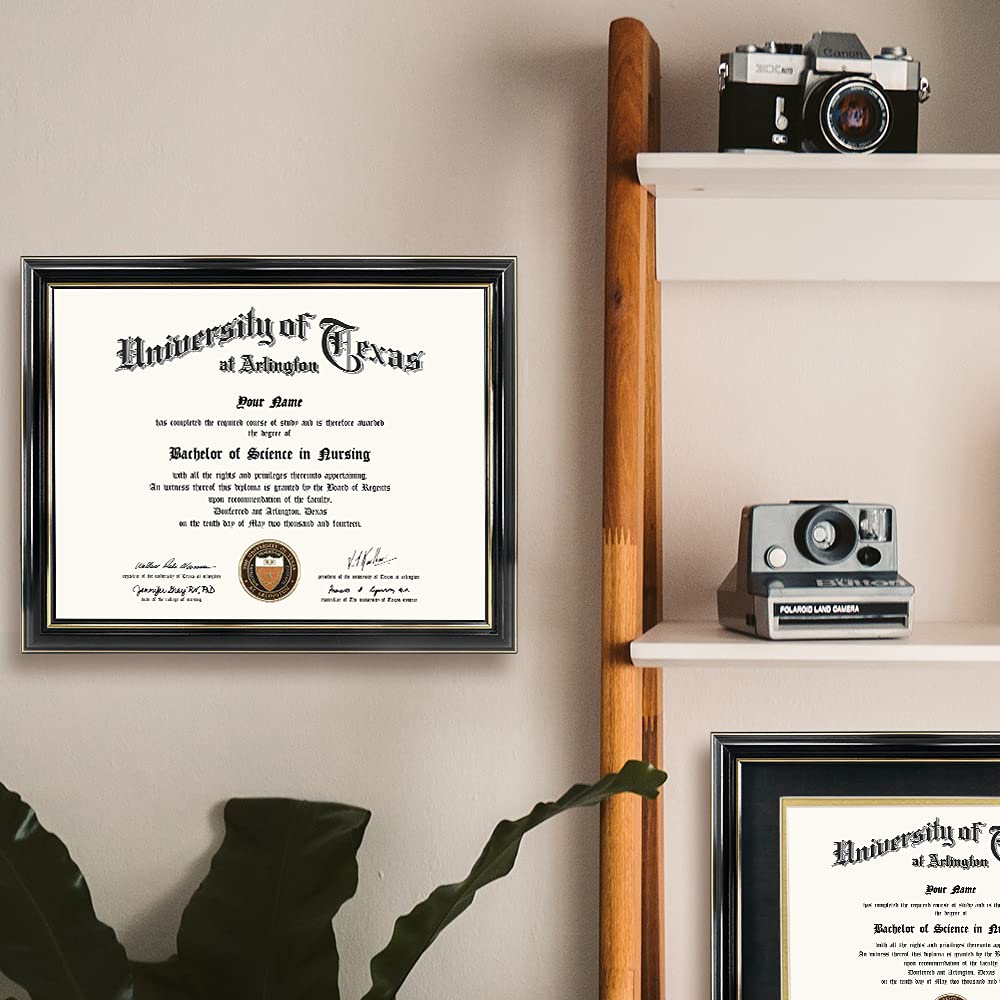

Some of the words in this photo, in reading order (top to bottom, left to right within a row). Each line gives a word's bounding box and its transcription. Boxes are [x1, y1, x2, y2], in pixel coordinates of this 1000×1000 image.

[823, 48, 863, 58] Canon
[114, 306, 275, 372] University
[279, 312, 317, 342] of
[318, 317, 426, 374] Texas
[219, 355, 236, 374] at
[238, 354, 320, 376] Arlington
[236, 394, 265, 410] Your
[269, 395, 303, 409] Name
[155, 418, 167, 428] has
[170, 418, 202, 428] completed
[204, 418, 214, 428] the
[217, 418, 243, 428] required
[246, 419, 267, 427] course
[270, 418, 277, 427] of
[301, 418, 313, 427] and
[326, 418, 354, 428] therefore
[357, 419, 384, 427] awarded
[248, 428, 258, 438] the
[261, 429, 281, 439] degree
[284, 428, 291, 438] of
[169, 446, 223, 462] Bachelor
[229, 446, 240, 460] of
[247, 446, 293, 461] Science
[299, 446, 311, 461] in
[317, 446, 371, 463] Nursing
[172, 470, 187, 480] with
[190, 470, 199, 480] all
[202, 471, 212, 480] the
[216, 470, 236, 481] rights
[239, 471, 251, 480] and
[192, 482, 215, 493] thereof
[218, 482, 232, 492] this
[234, 482, 261, 493] diploma
[274, 483, 299, 493] granted
[313, 483, 323, 493] the
[326, 482, 349, 493] Board
[351, 482, 358, 492] of
[361, 482, 390, 493] Regents
[208, 496, 224, 505] upon
[284, 494, 291, 504] of
[294, 495, 304, 505] the
[179, 520, 187, 528] on
[190, 519, 200, 528] the
[203, 519, 220, 528] tenth
[223, 519, 235, 529] day
[238, 518, 244, 528] of
[248, 518, 265, 529] May
[268, 520, 281, 528] two
[284, 519, 314, 529] thousand
[317, 519, 330, 528] and
[779, 605, 812, 614] POLAROID
[814, 605, 831, 614] LAND
[832, 605, 859, 614] CAMERA
[831, 817, 955, 868] University
[957, 821, 987, 844] of
[912, 854, 925, 868] at
[927, 853, 989, 870] Arlington
[924, 884, 948, 896] Your
[949, 884, 977, 895] Name
[872, 923, 916, 935] Bachelor
[919, 923, 930, 934] of
[932, 923, 970, 934] Science
[973, 923, 983, 934] in
